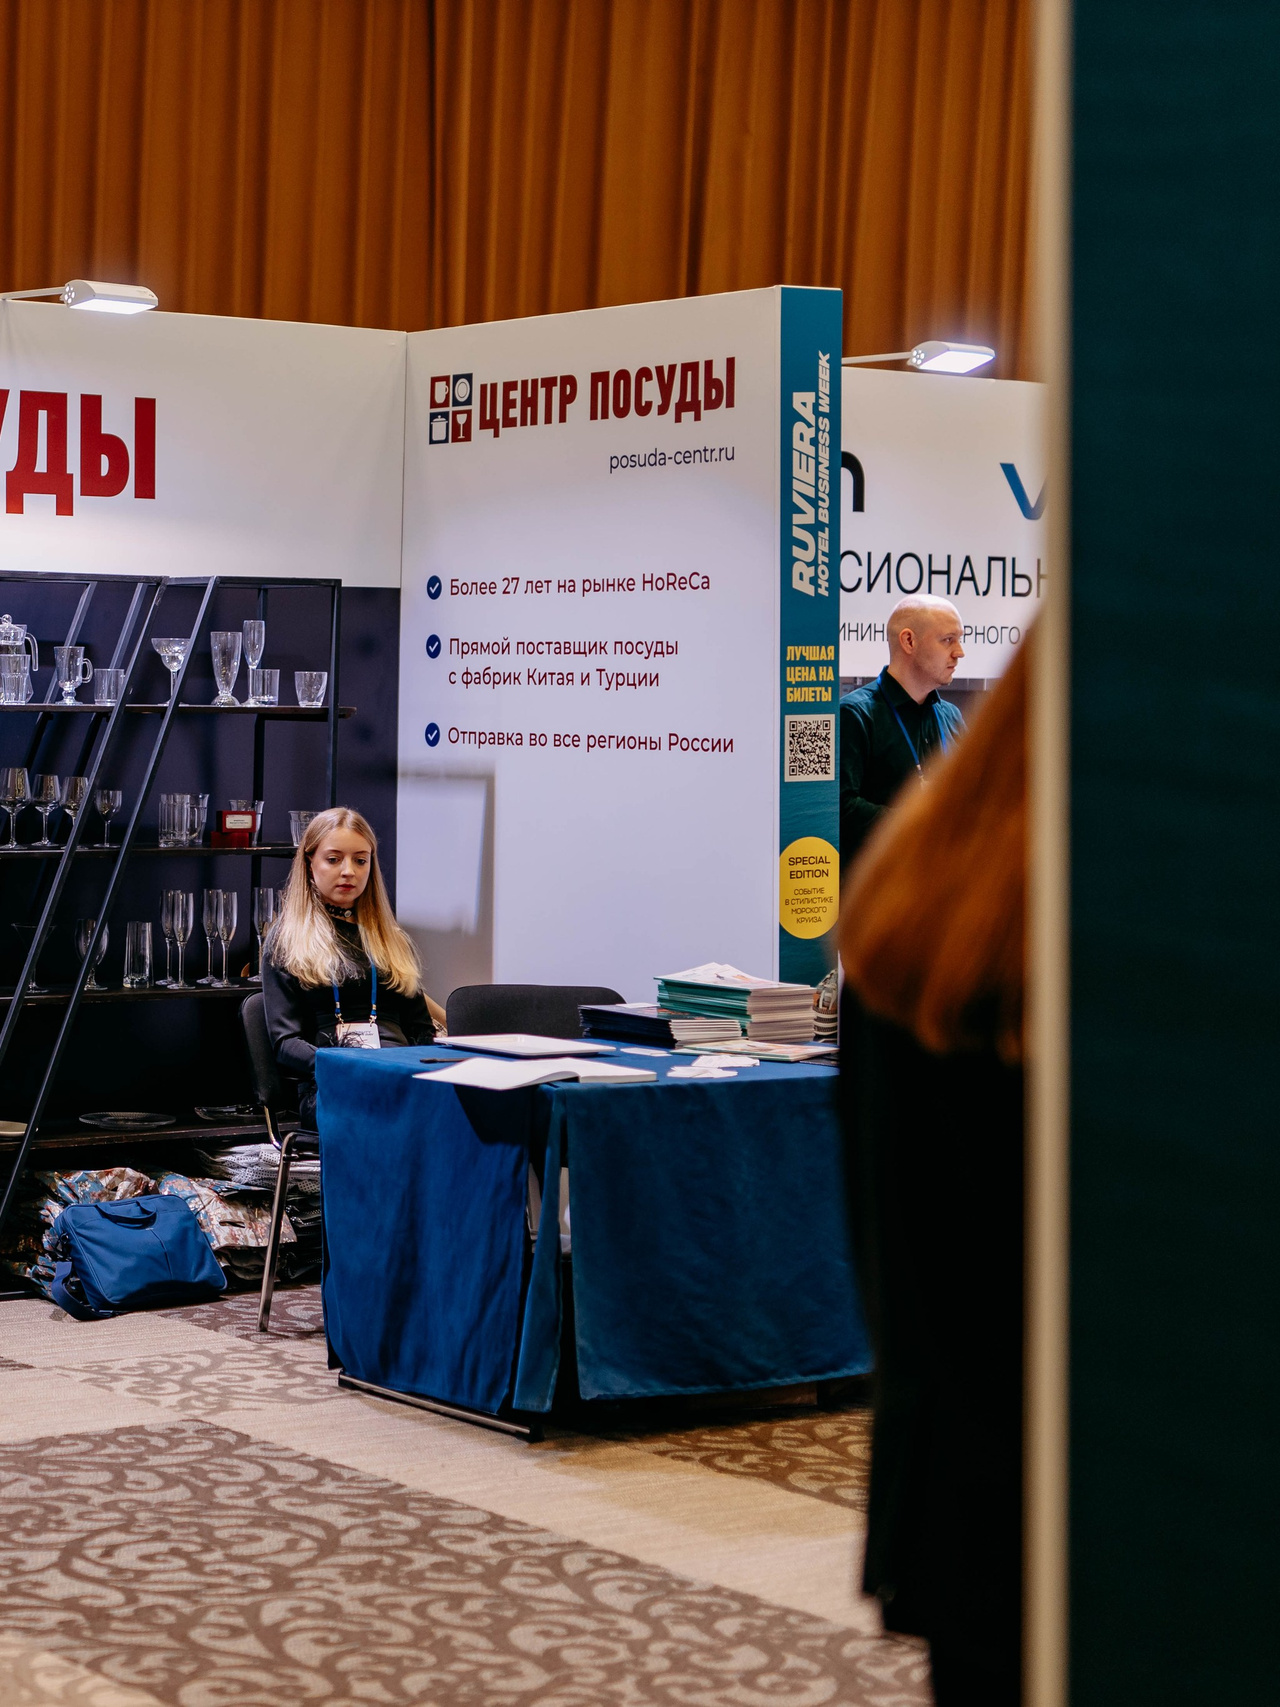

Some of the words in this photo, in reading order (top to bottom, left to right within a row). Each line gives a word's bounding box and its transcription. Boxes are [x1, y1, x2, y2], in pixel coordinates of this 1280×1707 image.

[818, 350, 830, 413] WEEK
[479, 374, 578, 438] ЦЕНТР
[590, 357, 735, 424] ПОСУДЫ
[609, 445, 735, 473] posuda-centr.ru
[818, 416, 830, 524] BUSINESS
[792, 391, 816, 597] RUVIERA
[817, 526, 829, 597] HOTEL
[450, 578, 497, 595] Более
[502, 577, 520, 595] 27
[524, 579, 552, 594] лет
[557, 579, 576, 593] на
[582, 575, 636, 597] рынке
[642, 572, 711, 592] HoReCa
[840, 622, 888, 642] ИНИН
[959, 625, 1021, 644] РНОГО
[449, 637, 511, 659] Прямой
[516, 640, 608, 657] поставщик
[614, 639, 679, 659] посуды
[786, 645, 835, 661] ЛУЧШАЯ
[448, 672, 457, 685] с
[461, 666, 522, 689] фабрик
[527, 668, 575, 686] Китая
[580, 672, 591, 686] и
[596, 669, 659, 691] Турции
[786, 666, 817, 684] ЦЕНА
[819, 666, 834, 681] НА
[786, 687, 832, 702] БИЛЕТЫ
[448, 727, 523, 748] Отправка
[529, 732, 548, 747] во
[553, 732, 581, 748] все
[586, 733, 661, 752] регионы
[668, 733, 734, 753] России
[788, 856, 830, 866] SPECIAL
[789, 869, 829, 879] EDITION
[791, 896, 833, 905] СТИЛИСТИКЕ
[794, 887, 825, 895] СОБЫТИЕ
[791, 906, 827, 914] МОРСКОГО
[796, 916, 822, 924] КРУИЗА
